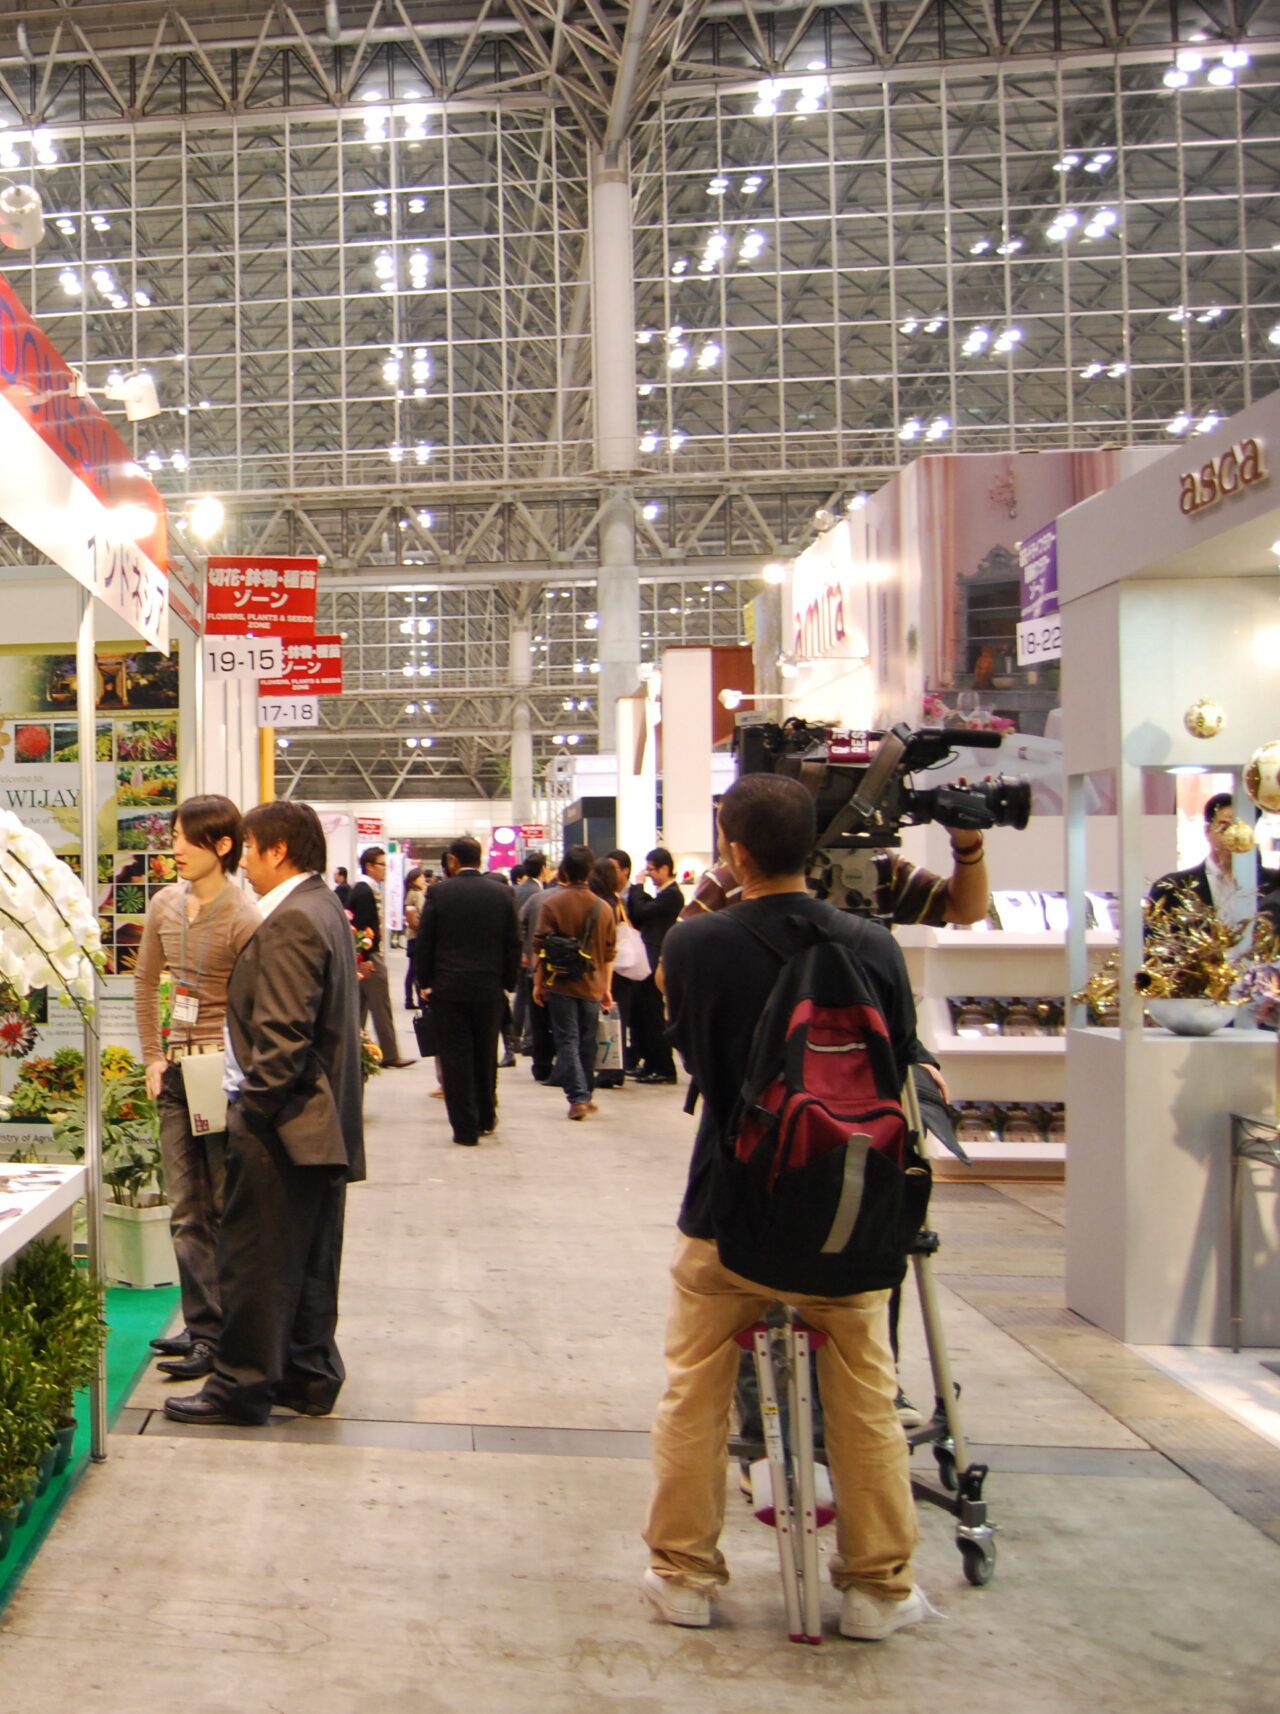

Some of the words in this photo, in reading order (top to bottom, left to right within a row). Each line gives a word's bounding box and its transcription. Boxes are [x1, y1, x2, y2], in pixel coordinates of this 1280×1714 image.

[1179, 438, 1266, 515] asca
[233, 589, 289, 608] ゾーン
[247, 613, 278, 621] PLANTS
[247, 621, 271, 629] ZONE
[1020, 627, 1062, 655] 18-22
[208, 650, 275, 673] 19-15
[281, 661, 322, 676] ゾーン
[261, 704, 313, 721] 17-18
[6, 789, 80, 808] WIJAY
